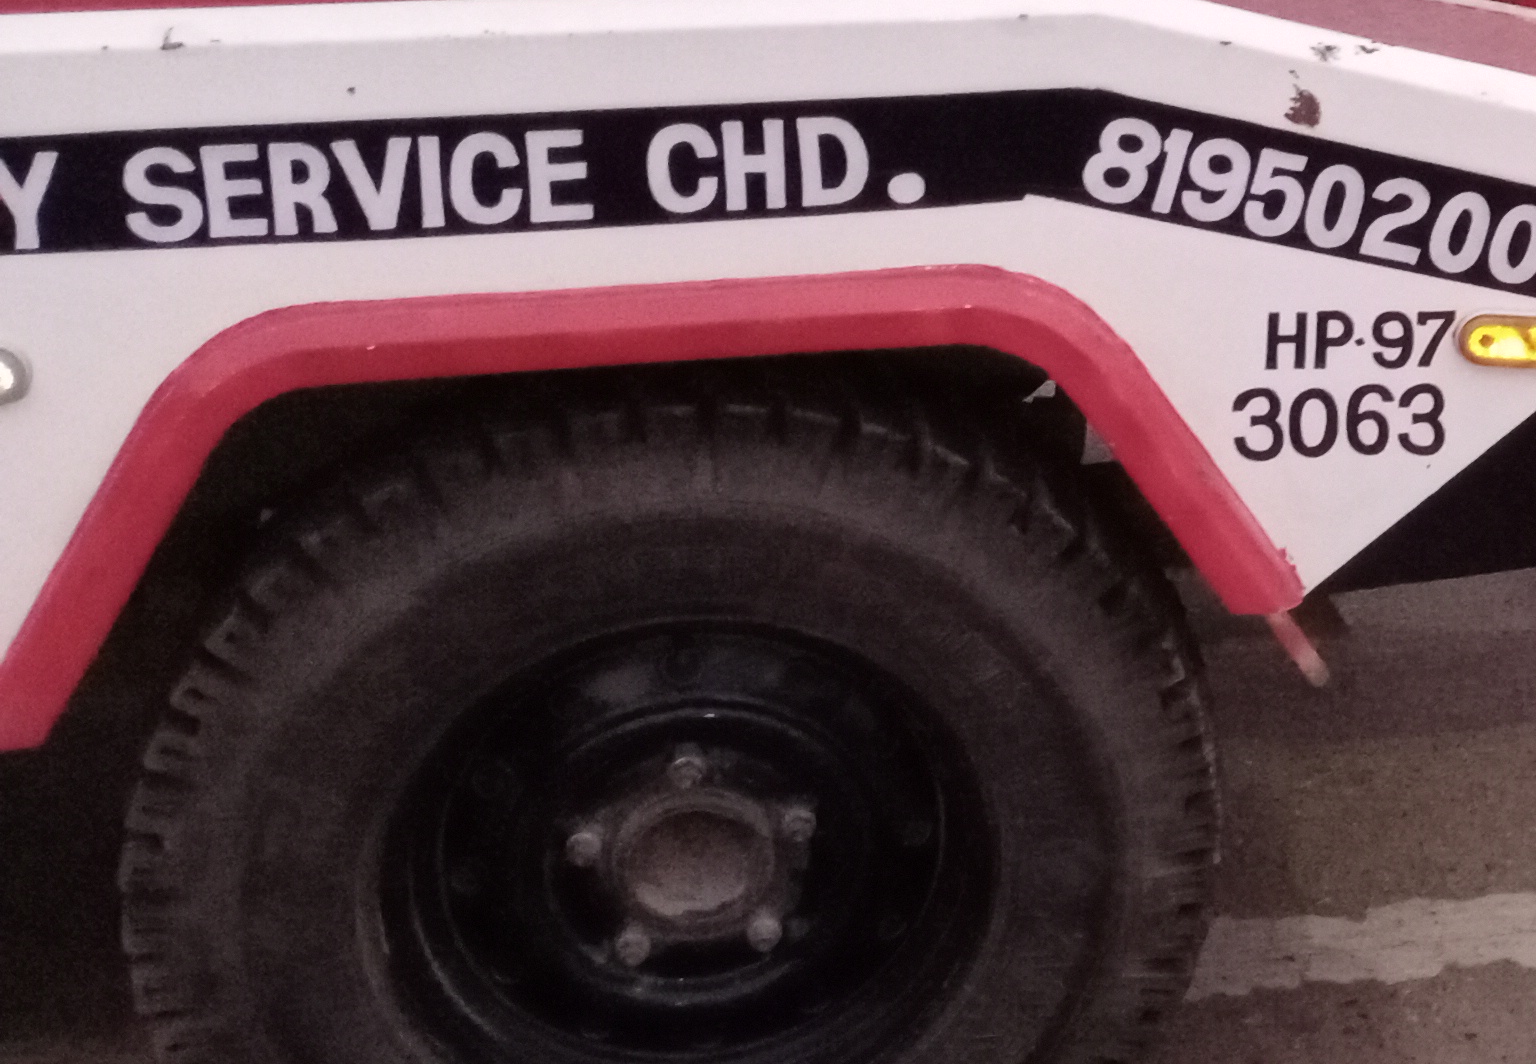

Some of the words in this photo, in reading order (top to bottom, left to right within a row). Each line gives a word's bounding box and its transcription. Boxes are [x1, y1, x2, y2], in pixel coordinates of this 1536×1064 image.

[124, 128, 594, 244] SERVICE
[647, 116, 927, 213] CHD.
[1232, 383, 1446, 462] 3063
